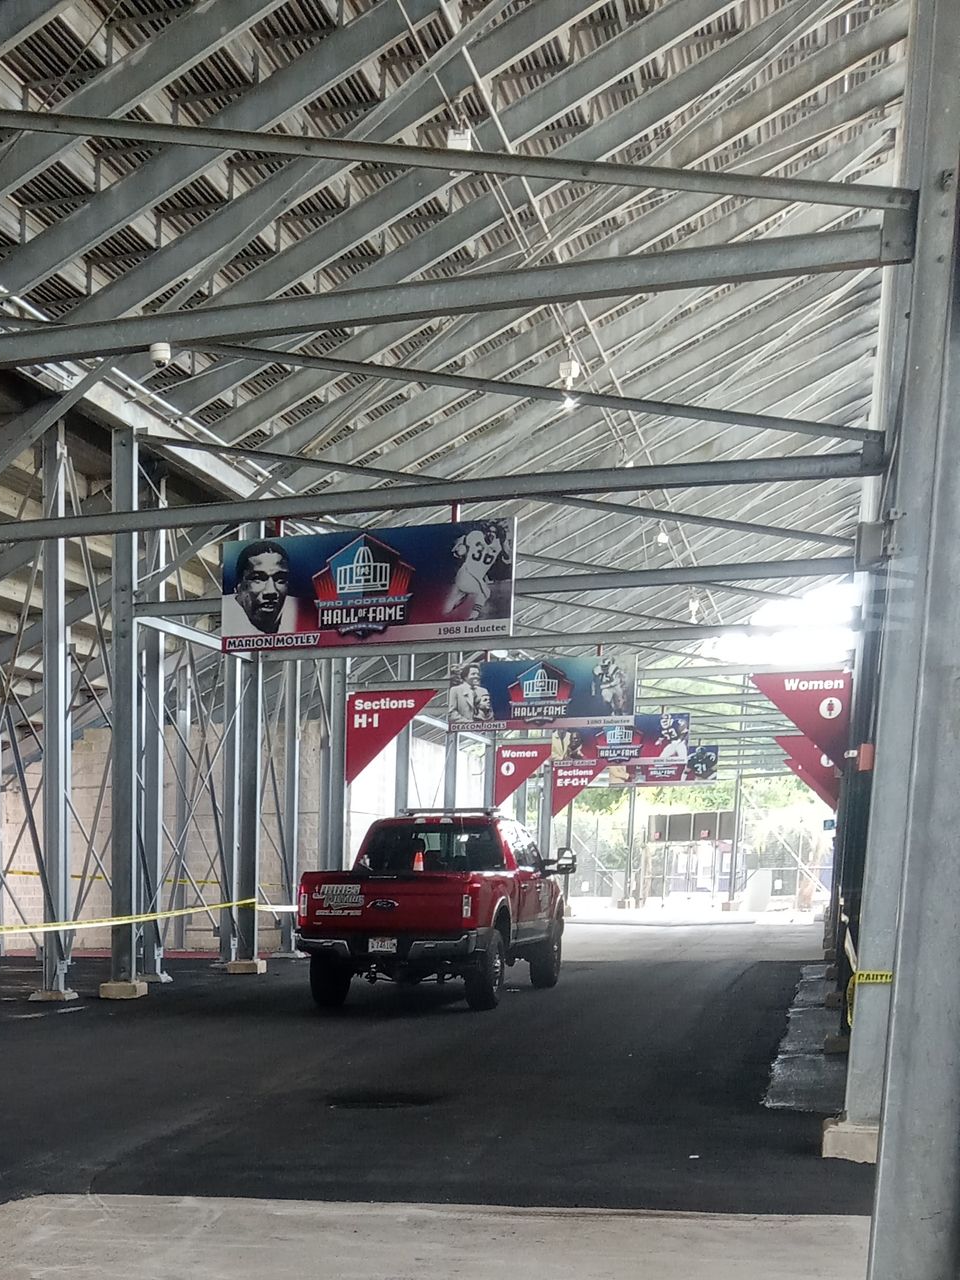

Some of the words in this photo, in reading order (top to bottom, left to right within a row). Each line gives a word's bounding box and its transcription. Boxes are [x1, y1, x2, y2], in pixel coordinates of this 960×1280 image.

[318, 600, 343, 608] PRO
[347, 596, 409, 606] FOOTBALL
[321, 608, 358, 625] HALL
[358, 608, 367, 617] OF
[367, 605, 405, 622] FAME
[437, 624, 461, 636] 1968
[464, 622, 507, 635] Inductee
[227, 636, 273, 649] MARION
[274, 633, 320, 648] MOTLEY
[784, 678, 845, 691] Women
[354, 697, 415, 711] Sections
[514, 706, 537, 717] HALL
[543, 705, 567, 715] FAME
[451, 724, 482, 732] DEACON
[484, 722, 507, 730] JONES
[501, 750, 538, 759] Women
[557, 769, 593, 777] Sections
